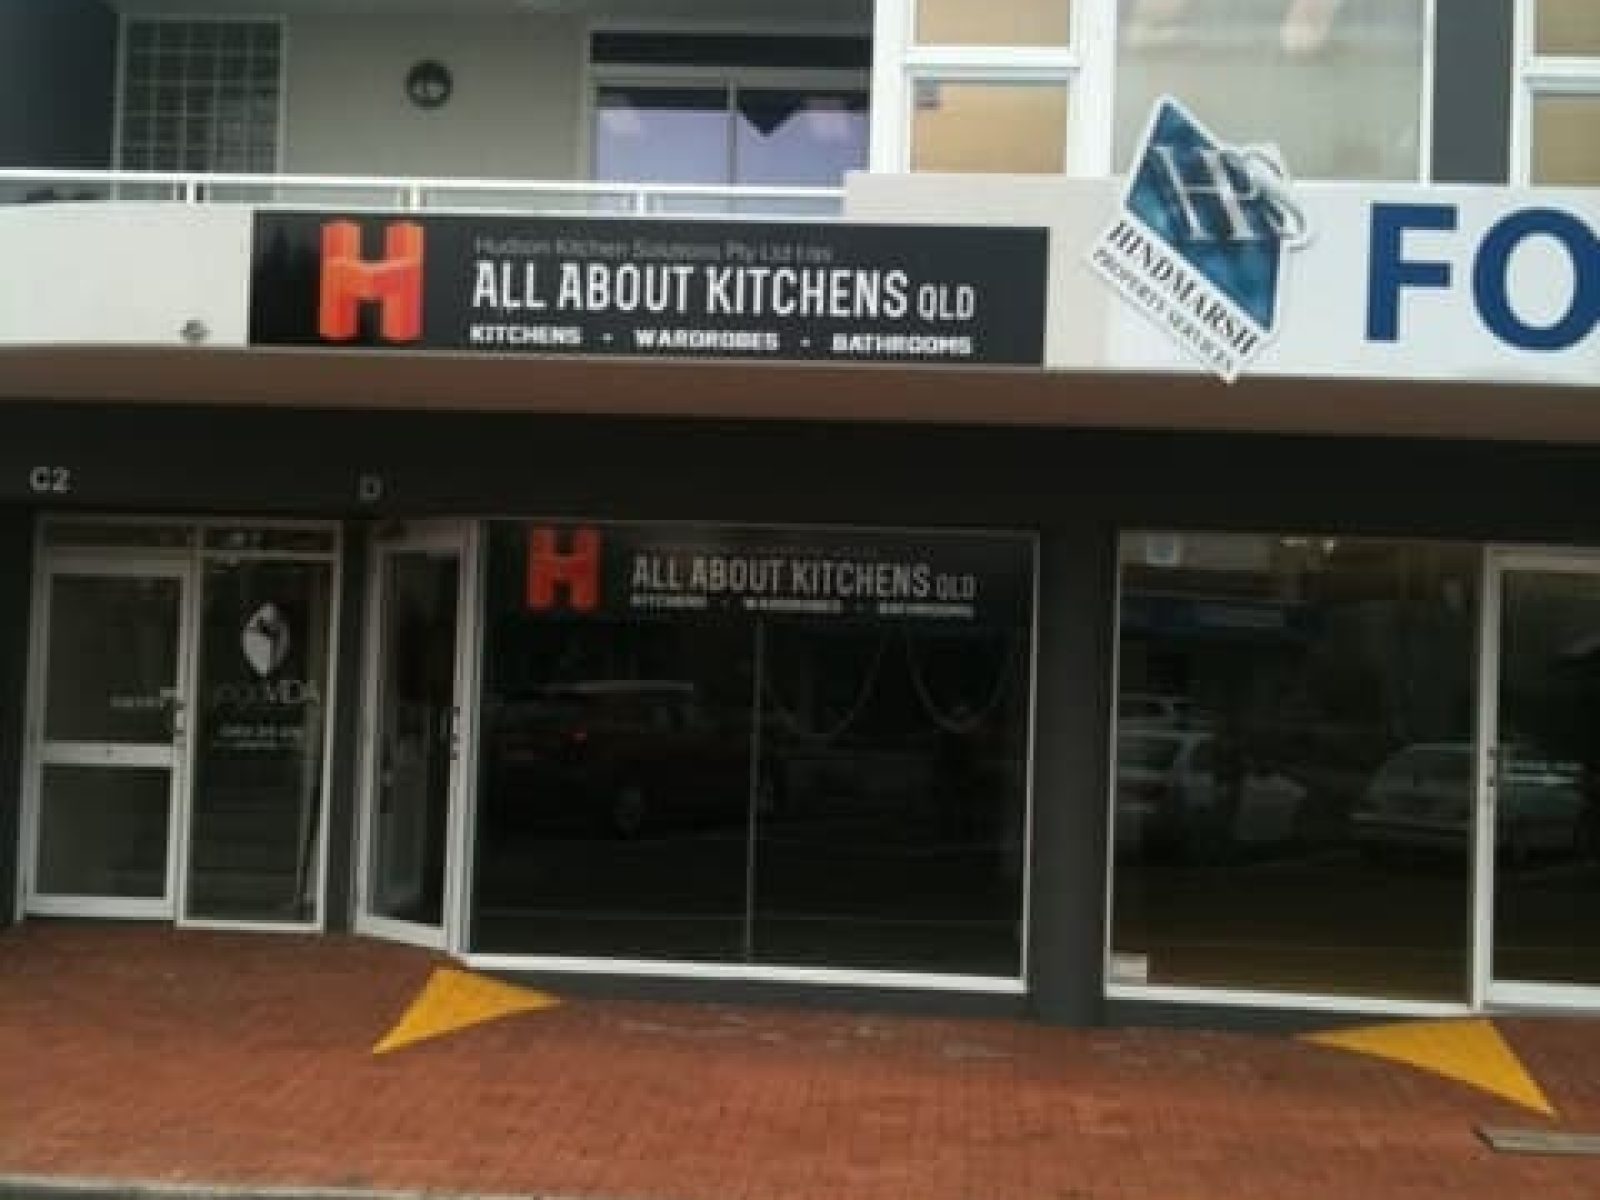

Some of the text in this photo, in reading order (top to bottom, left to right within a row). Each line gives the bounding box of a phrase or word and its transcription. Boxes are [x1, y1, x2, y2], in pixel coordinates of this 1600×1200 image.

[473, 260, 976, 321] ALL ABOUT KITCHENS QLD
[1107, 220, 1260, 356] HINDMARSH
[1365, 203, 1600, 352] FO
[470, 325, 973, 355] KITCHENS WARDROBES BATHROOMS
[30, 466, 71, 493] C2
[632, 556, 681, 591] ALL
[692, 558, 783, 593] ABOUT
[792, 561, 931, 598] KITCHENS
